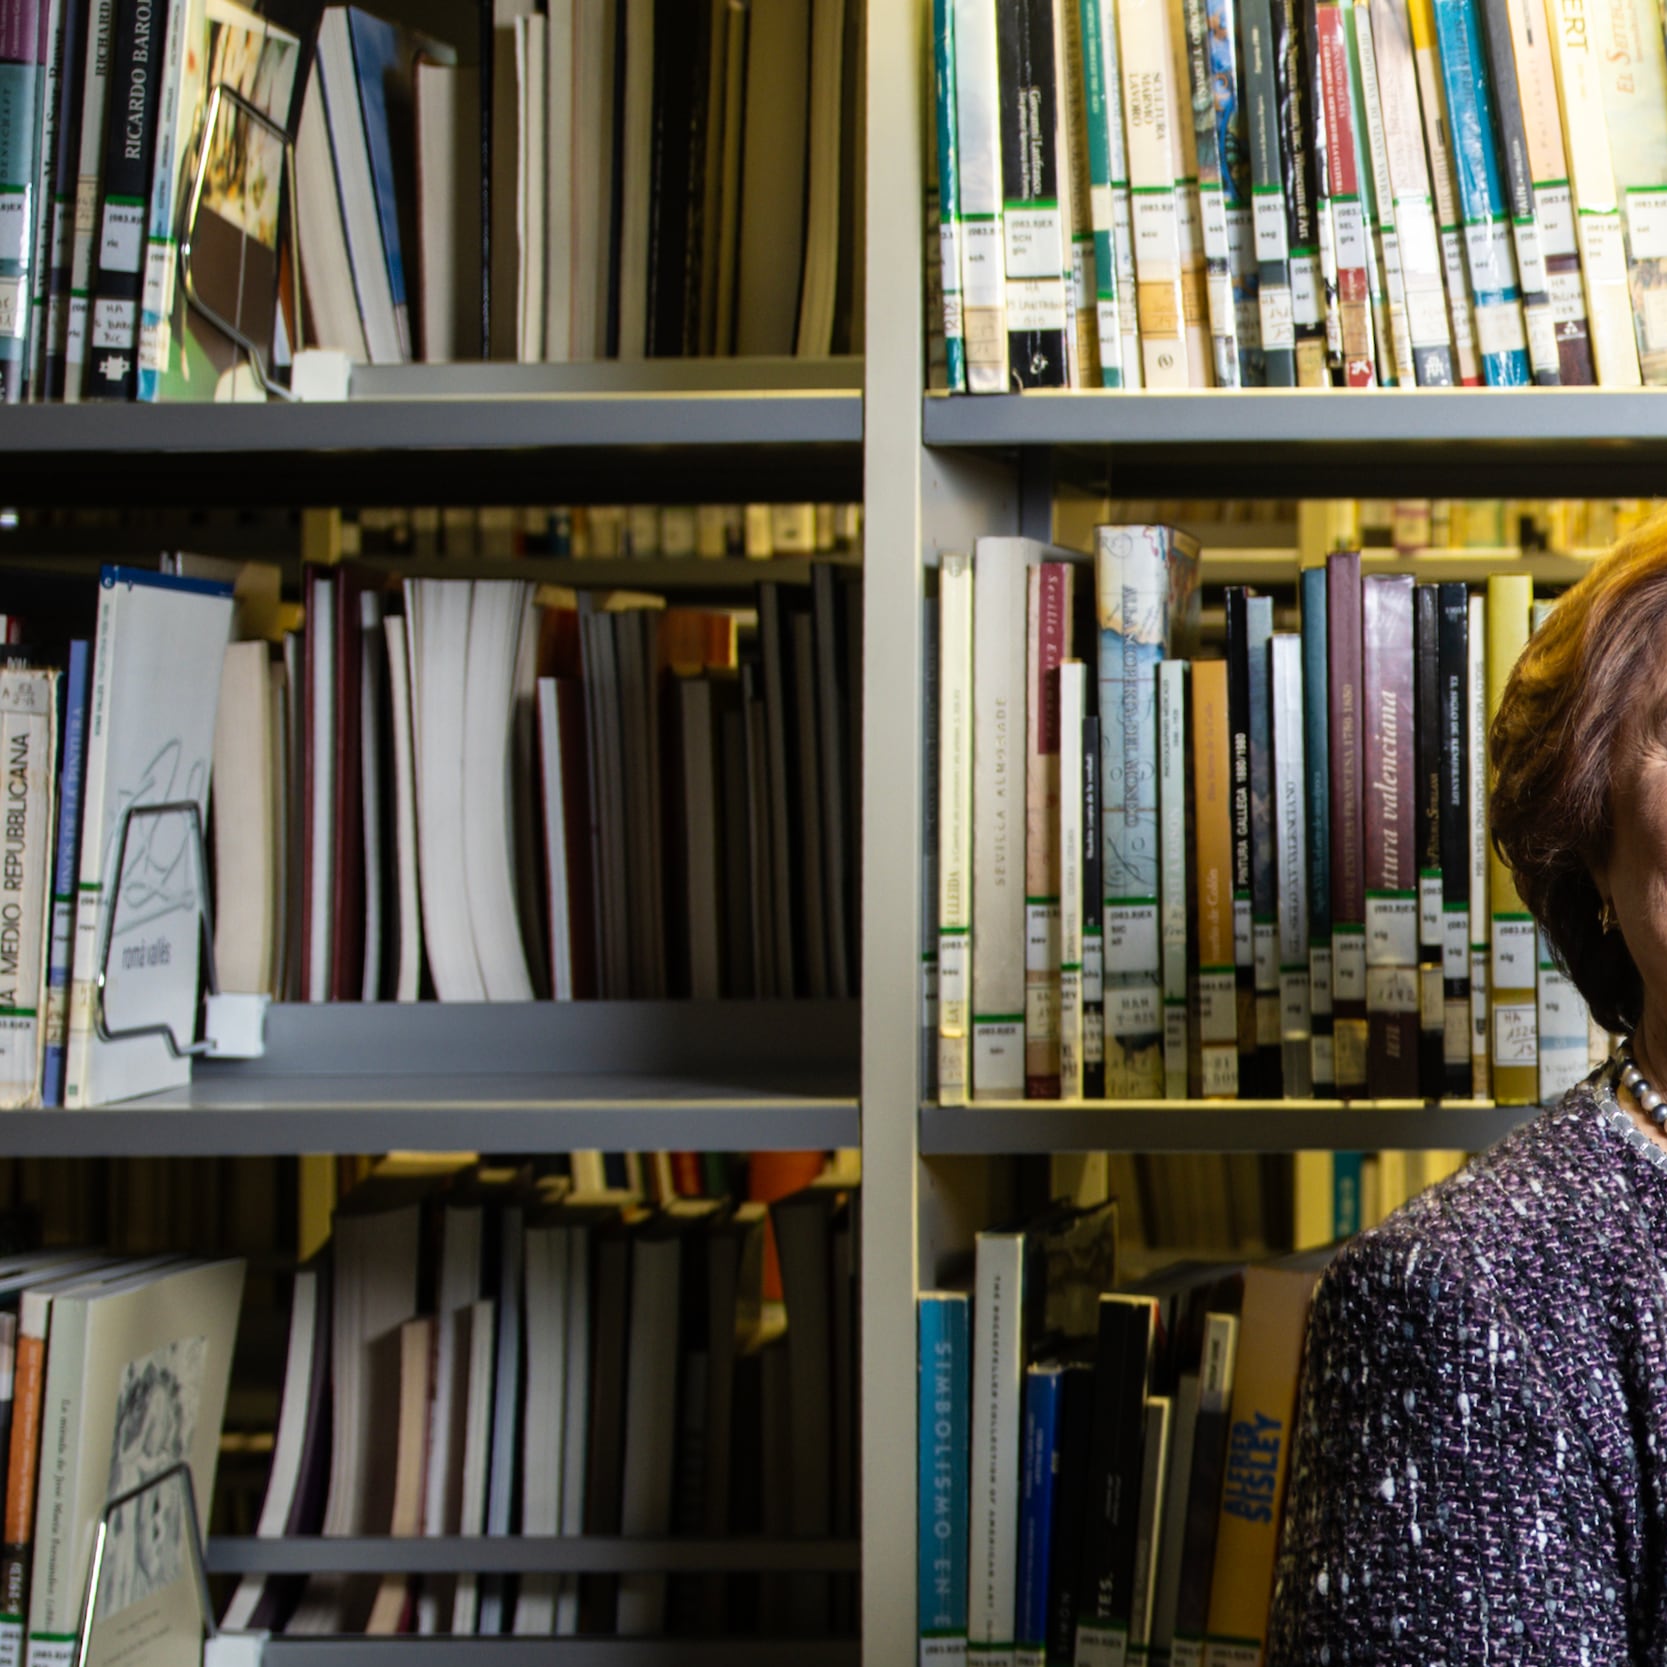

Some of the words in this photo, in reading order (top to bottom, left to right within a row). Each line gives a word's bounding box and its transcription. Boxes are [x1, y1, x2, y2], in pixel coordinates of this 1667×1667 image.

[124, 69, 147, 159] RICARDO
[3, 732, 30, 892] REPUBBLICANA
[1373, 691, 1397, 820] valenciana
[0, 903, 21, 975] MEDIO
[1245, 1411, 1283, 1524] SISLEY
